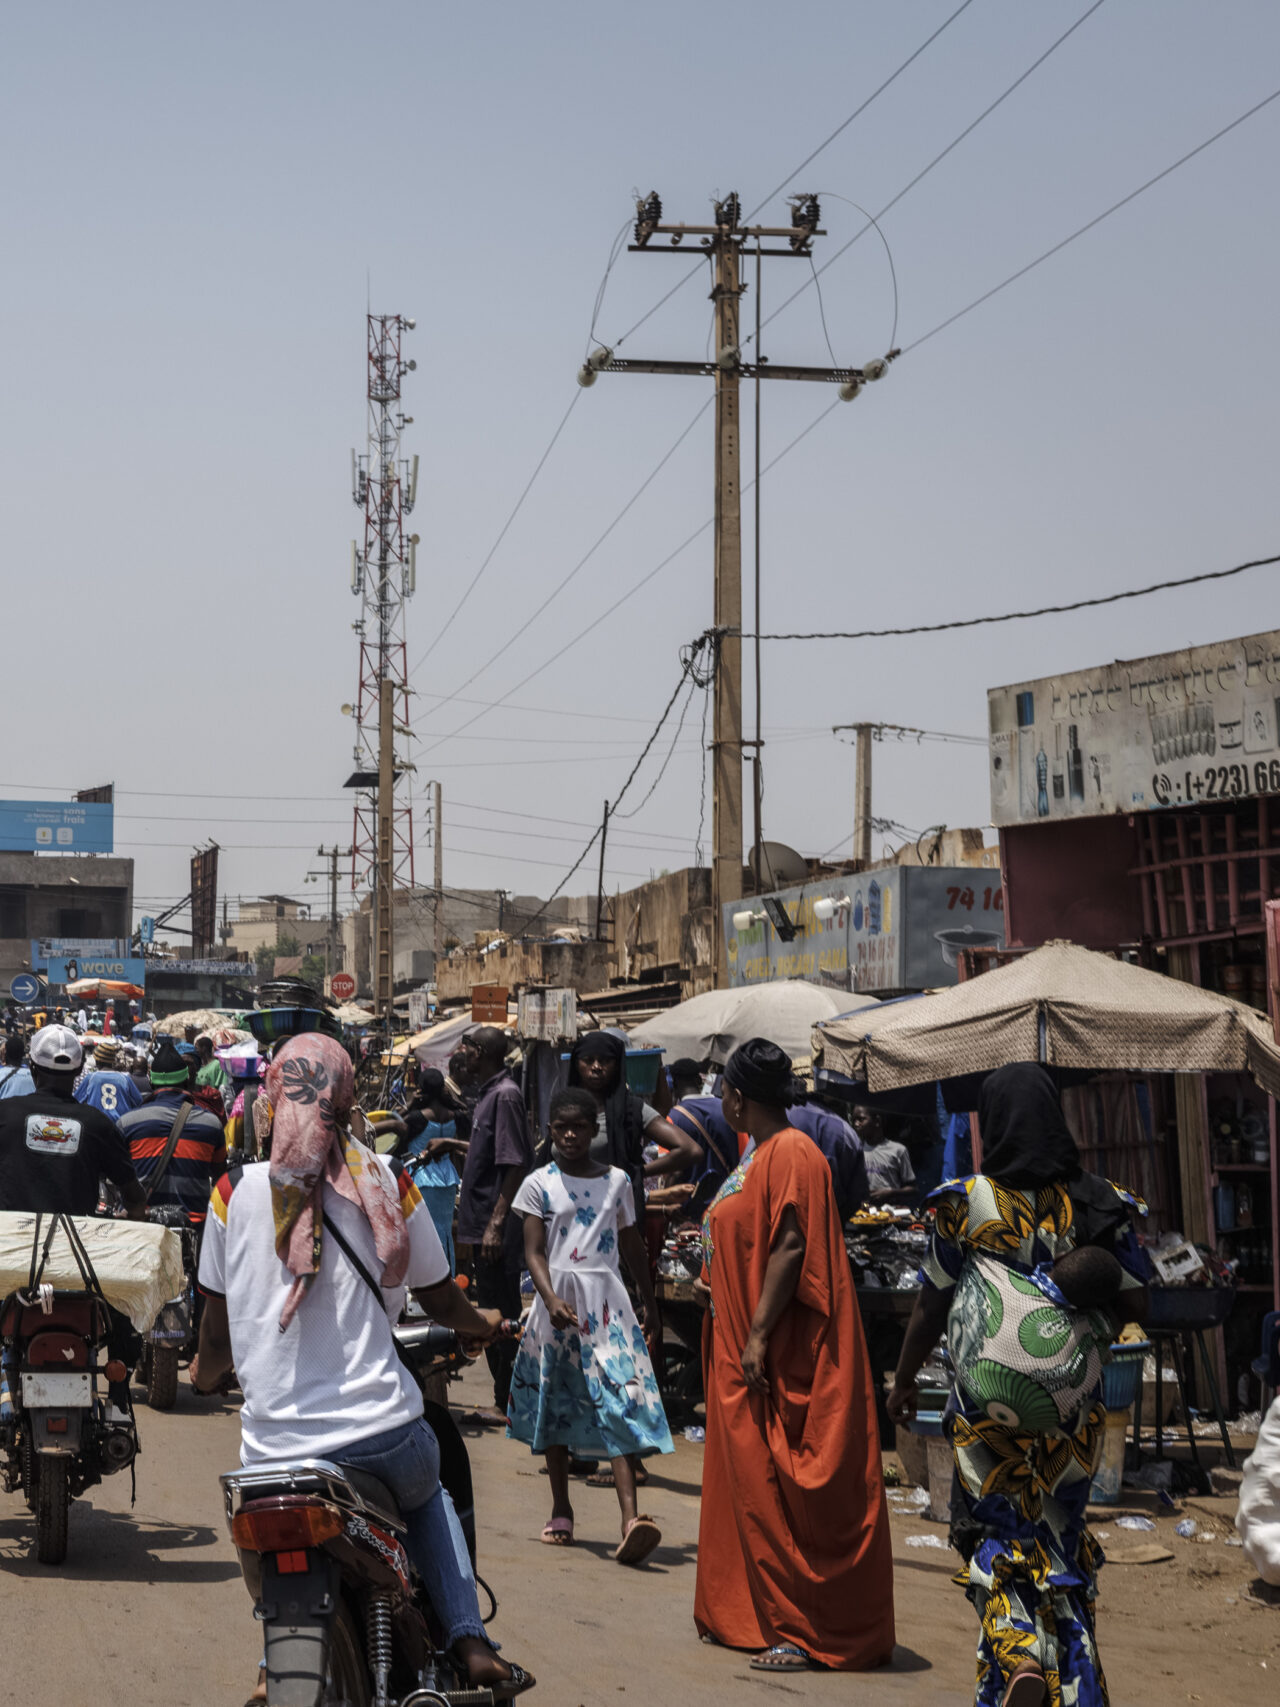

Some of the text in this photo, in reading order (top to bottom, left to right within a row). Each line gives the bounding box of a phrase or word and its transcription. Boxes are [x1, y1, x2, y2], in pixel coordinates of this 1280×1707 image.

[1184, 763, 1250, 801] (+223)
[63, 807, 87, 815] sans
[63, 815, 86, 824] frais
[946, 886, 974, 910] 74
[81, 962, 124, 974] wave
[332, 981, 354, 991] STOP
[101, 1083, 118, 1110] 8
